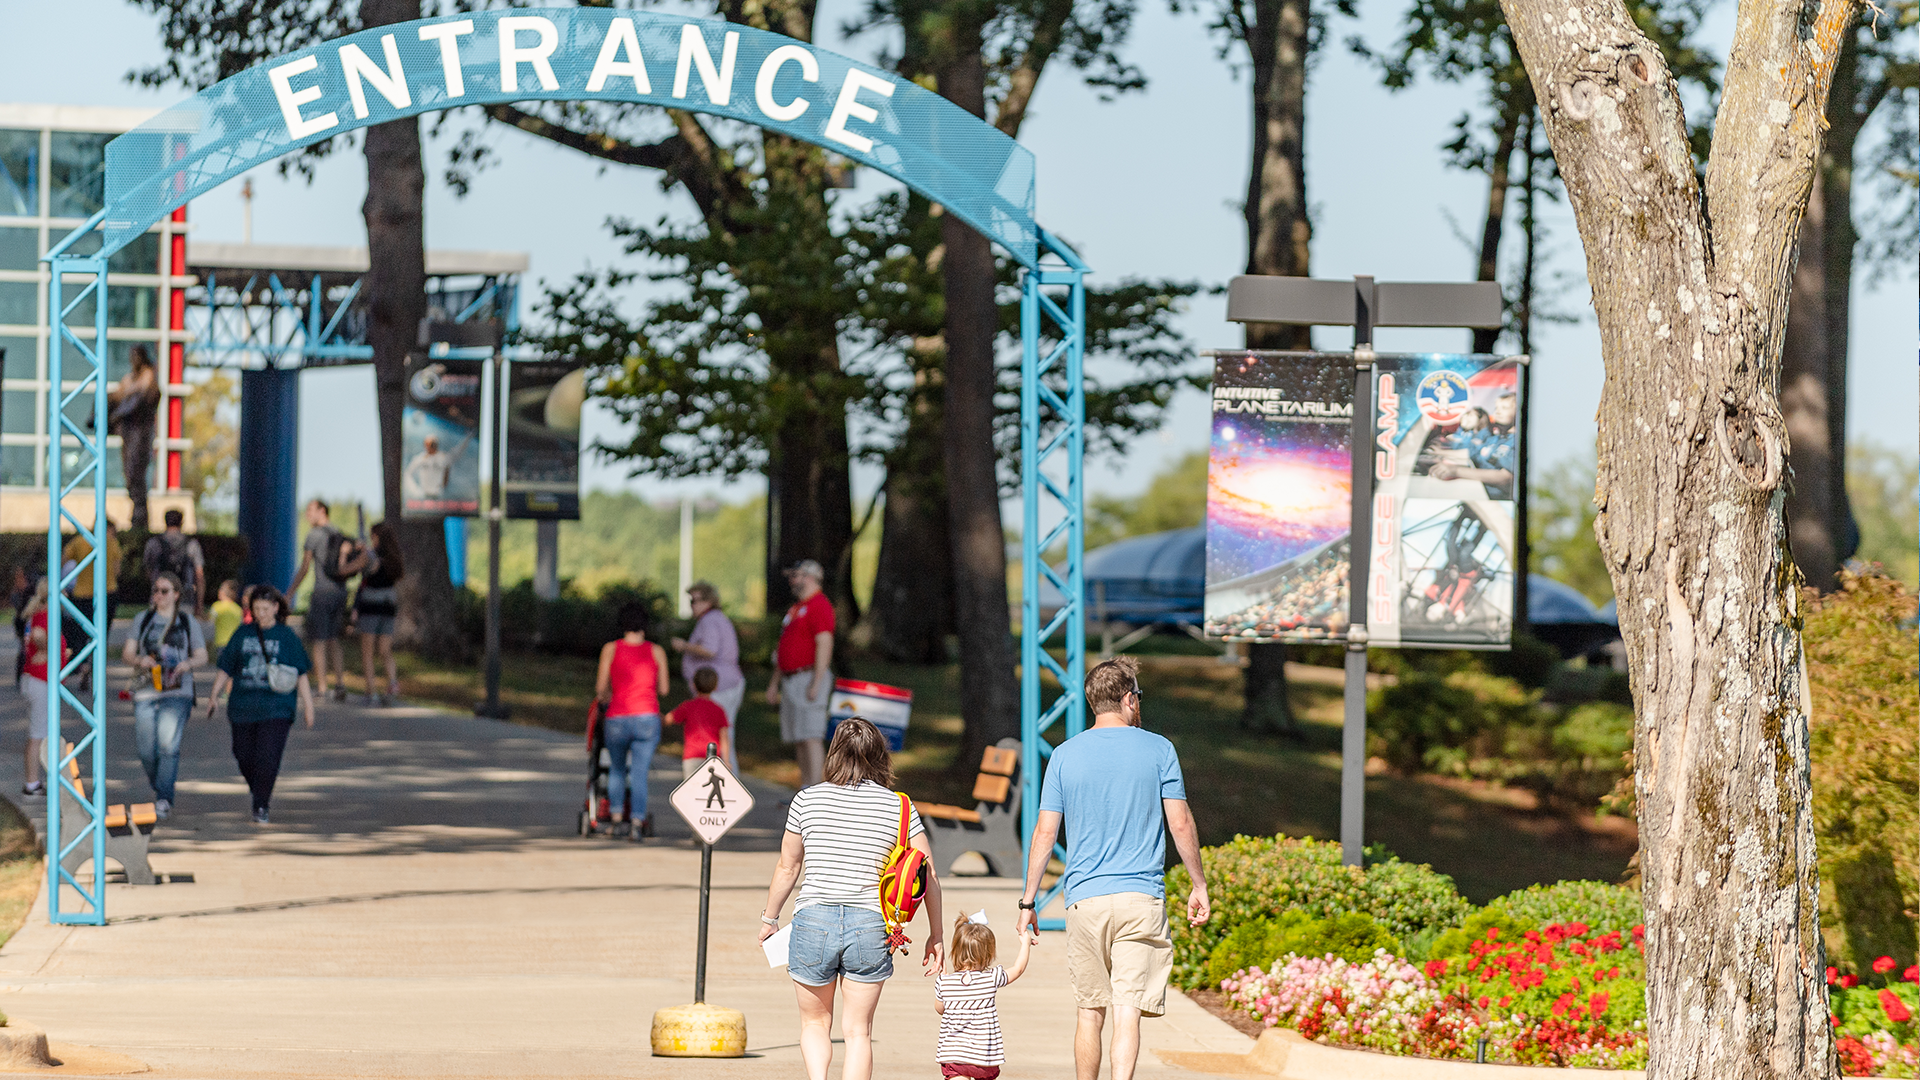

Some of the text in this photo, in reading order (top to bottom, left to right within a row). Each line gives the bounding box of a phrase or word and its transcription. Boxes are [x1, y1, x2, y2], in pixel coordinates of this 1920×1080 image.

[268, 16, 896, 153] ENTRANCE
[1214, 387, 1283, 400] INTUITIVE
[1213, 399, 1354, 417] PLANETARIUM
[1375, 373, 1400, 623] SPACE CAMP
[699, 816, 728, 826] ONLY
